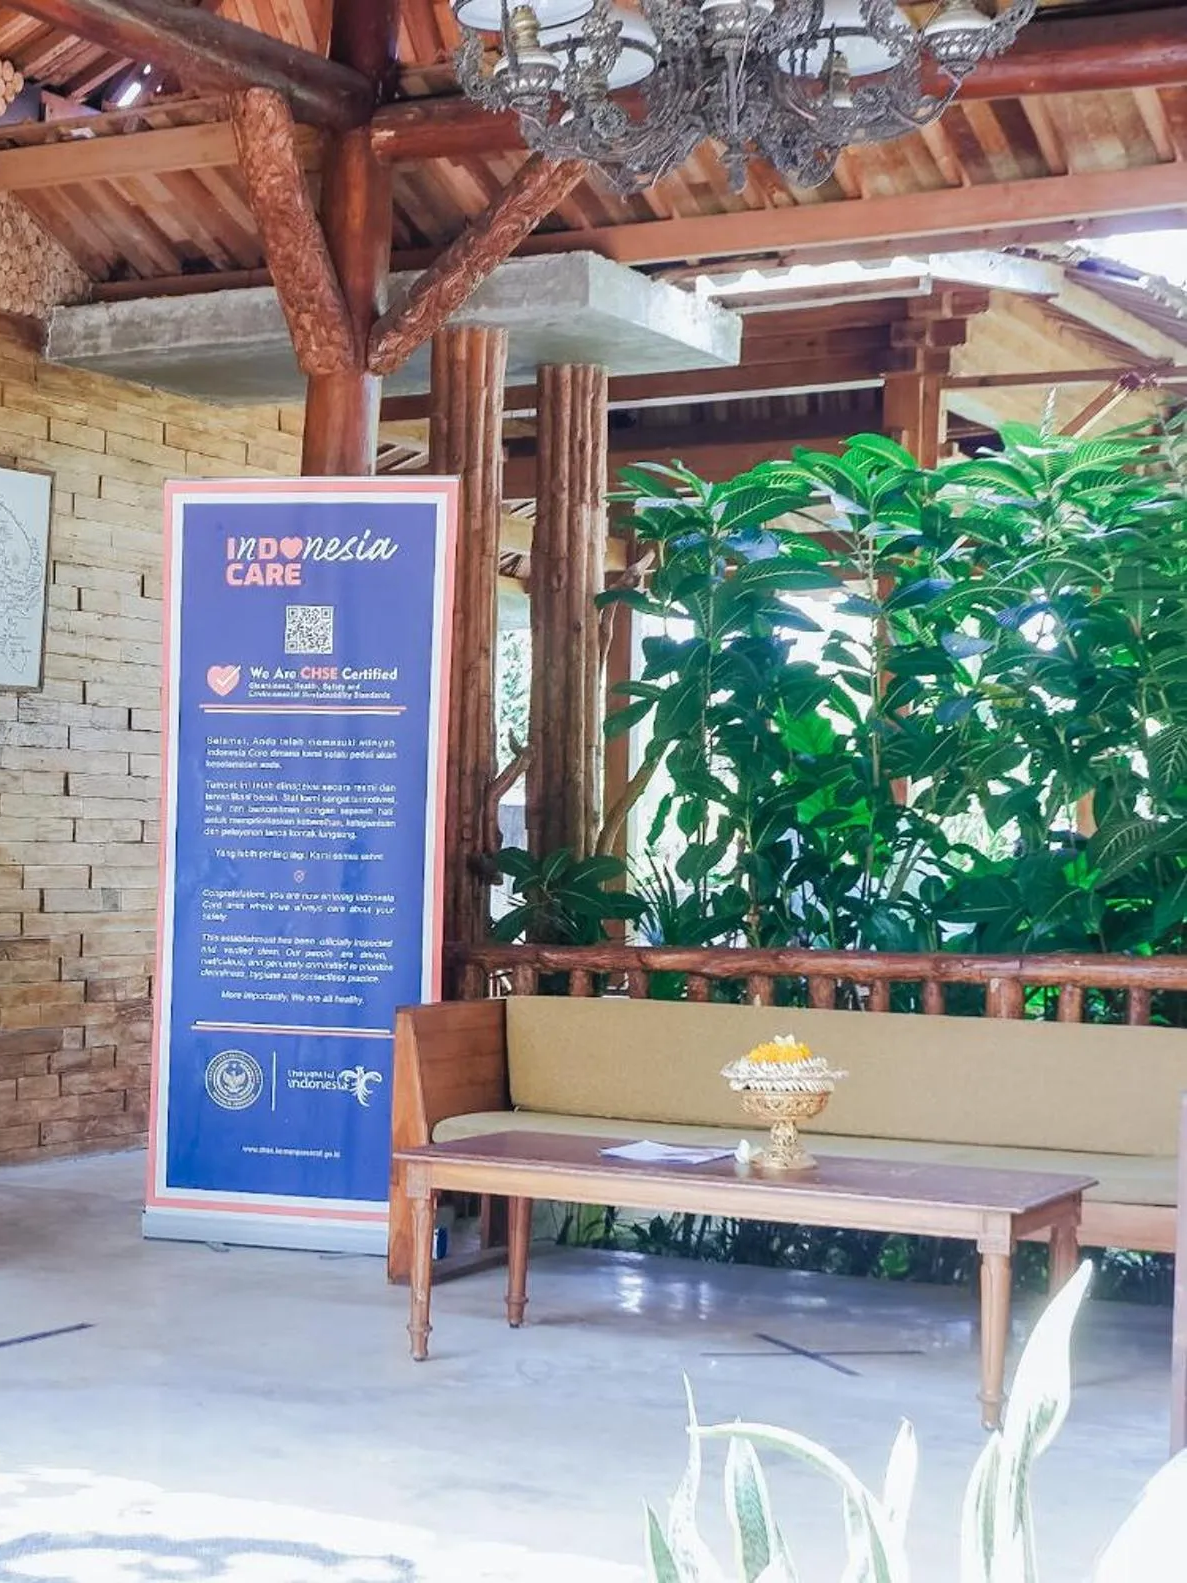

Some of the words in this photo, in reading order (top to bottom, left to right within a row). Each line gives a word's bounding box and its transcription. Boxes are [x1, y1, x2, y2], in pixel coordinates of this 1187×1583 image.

[226, 562, 302, 586] CARE
[250, 667, 269, 680] We
[273, 667, 296, 680] Are
[300, 666, 338, 680] CHSE
[341, 667, 398, 681] Certified
